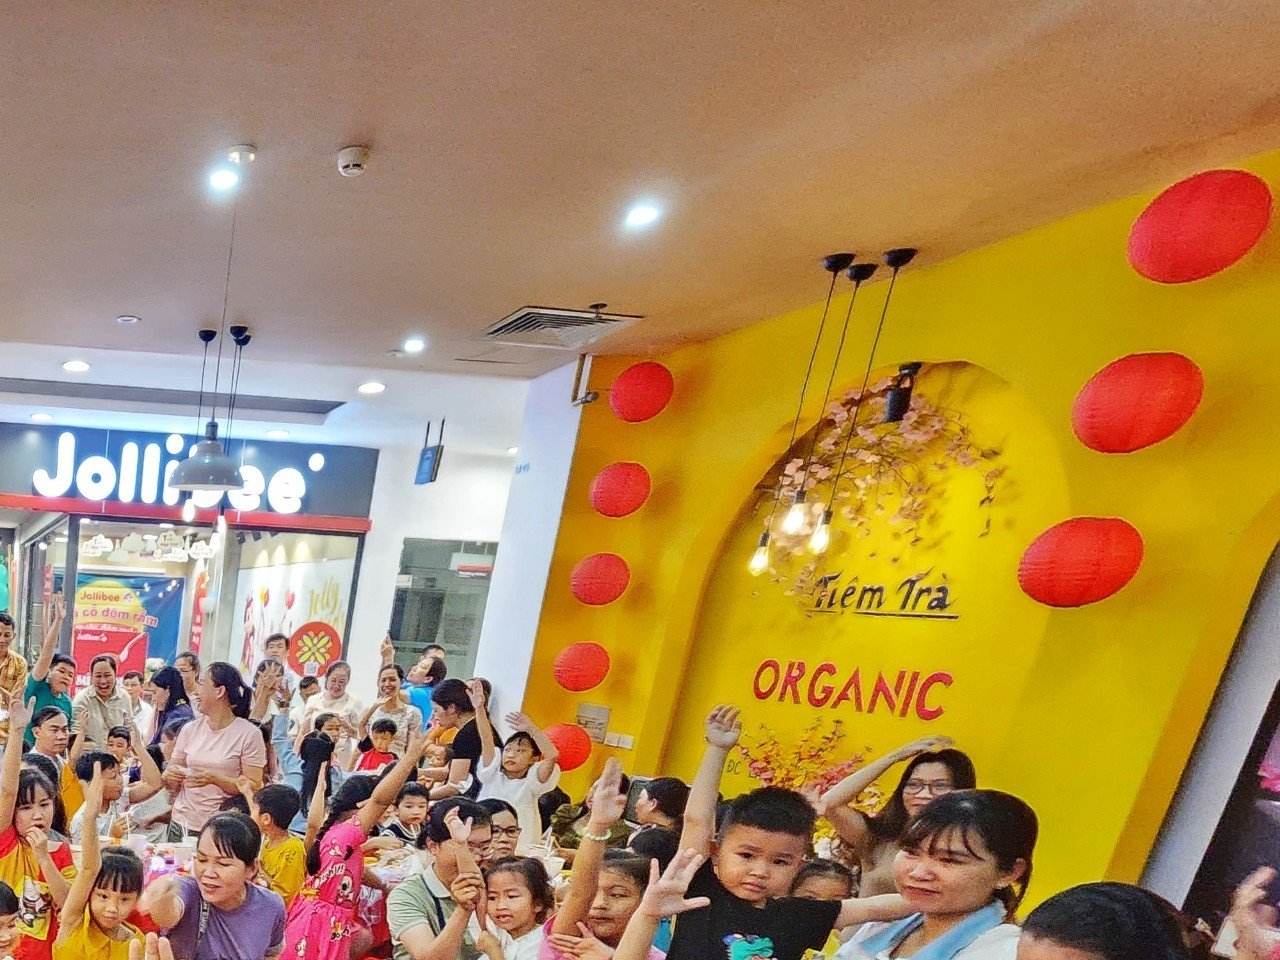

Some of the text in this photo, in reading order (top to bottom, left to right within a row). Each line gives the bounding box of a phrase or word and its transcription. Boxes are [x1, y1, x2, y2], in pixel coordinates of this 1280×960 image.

[80, 592, 120, 602] Jollibee
[815, 566, 958, 615] Tiệm Trà
[753, 659, 954, 721] ORGANIC
